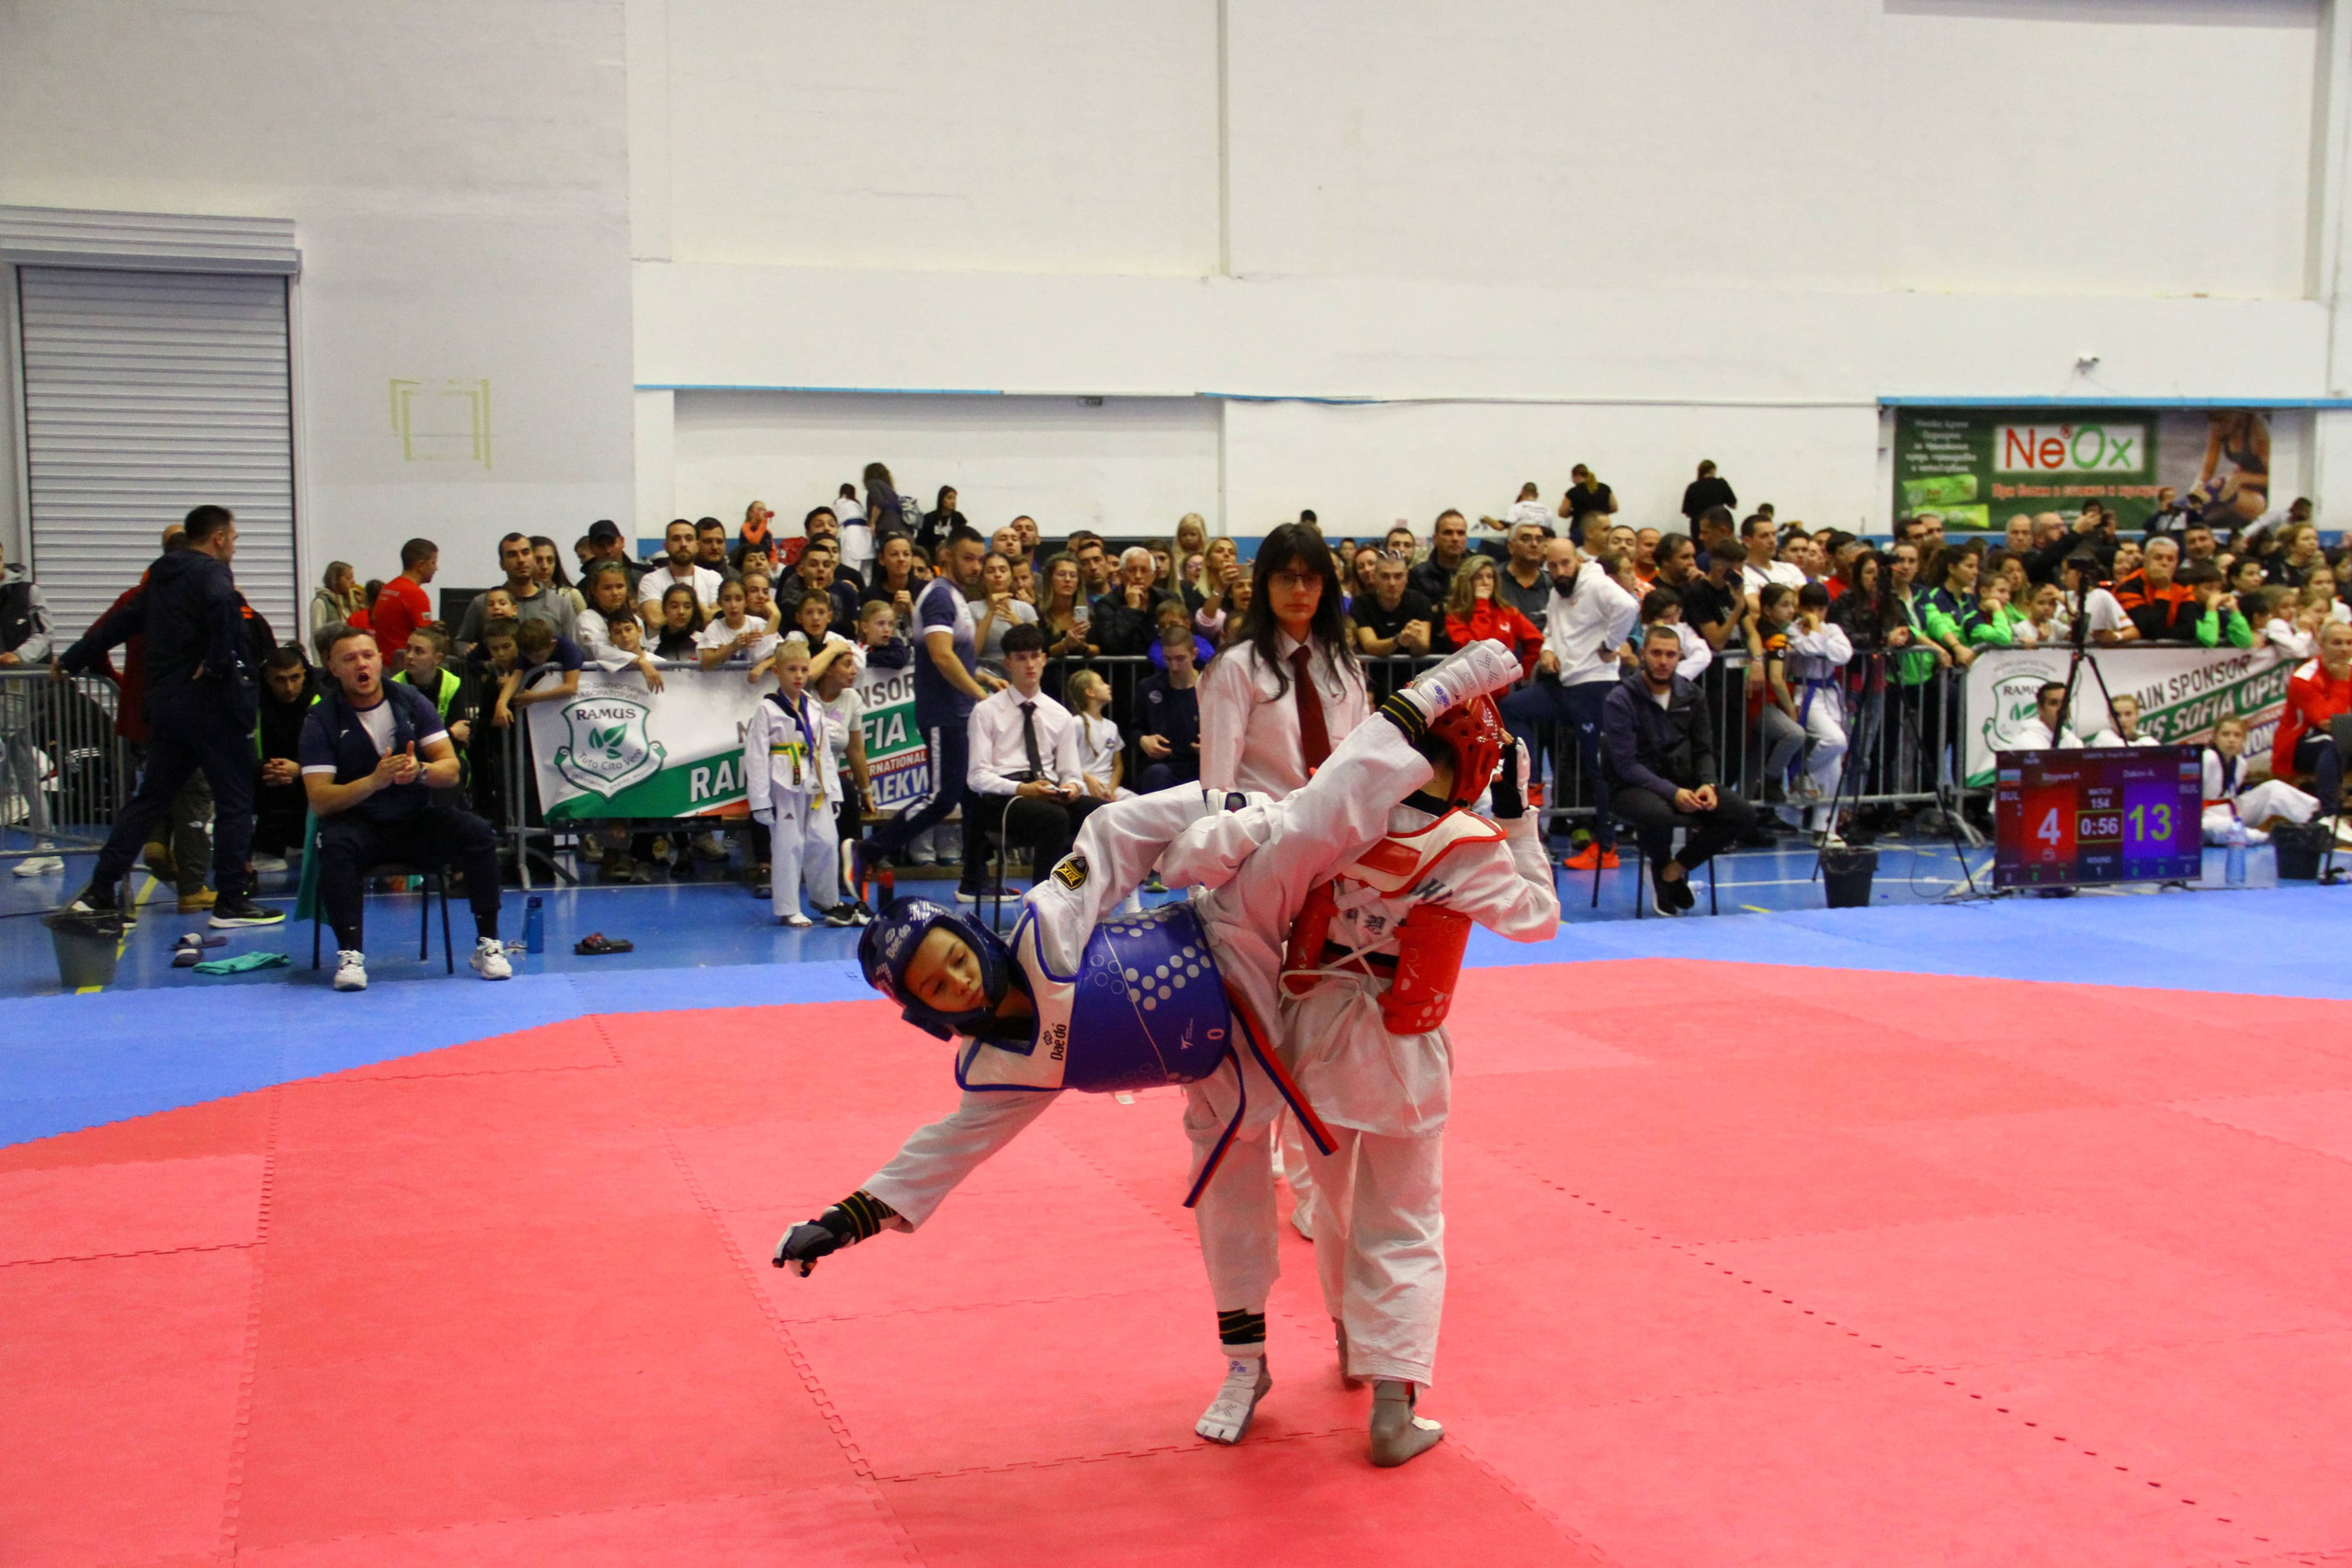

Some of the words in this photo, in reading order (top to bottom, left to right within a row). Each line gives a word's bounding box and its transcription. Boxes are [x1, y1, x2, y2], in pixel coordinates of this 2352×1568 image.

[858, 672, 915, 708] NSOR
[2136, 682, 2165, 712] AIN
[2168, 654, 2252, 701] SPONSOR
[576, 708, 637, 720] RAMUS
[862, 712, 907, 750] FIA
[2171, 690, 2236, 737] SOFIA
[579, 751, 599, 770] Tuto
[601, 761, 624, 771] Cito
[622, 748, 643, 766] Vere
[2000, 791, 2021, 801] BUL
[2091, 797, 2110, 809] 154
[2037, 807, 2062, 846] 4
[2080, 817, 2119, 836] 0:56
[2128, 803, 2172, 842] 13
